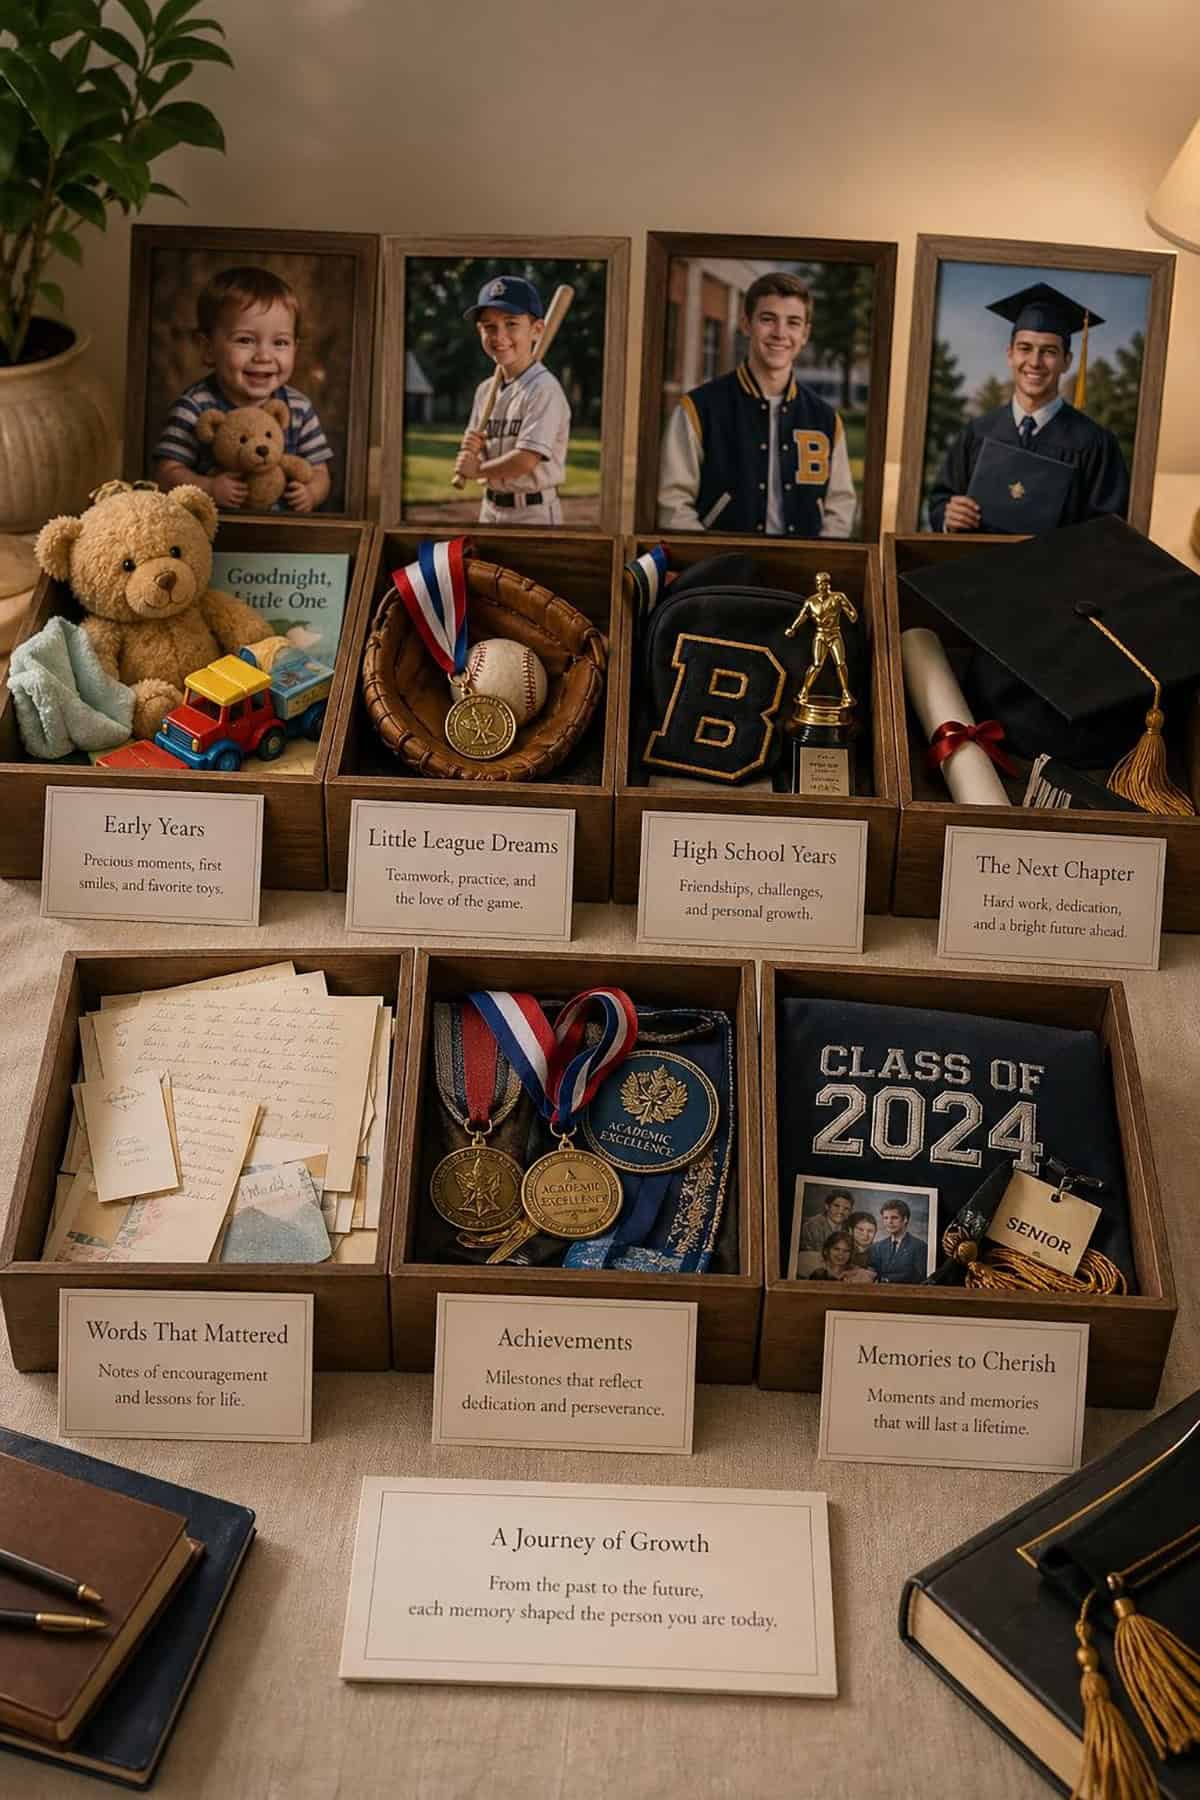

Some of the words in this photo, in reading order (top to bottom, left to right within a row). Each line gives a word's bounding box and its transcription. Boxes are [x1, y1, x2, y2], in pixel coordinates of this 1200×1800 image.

[793, 429, 830, 484] B
[228, 568, 332, 590] Goodnight,
[289, 592, 328, 608] One
[643, 633, 786, 780] B
[104, 815, 151, 840] Early
[159, 818, 205, 837] Years
[368, 828, 417, 848] Little
[423, 831, 485, 855] League
[492, 834, 558, 854] Dreams
[672, 840, 718, 865] High
[725, 842, 785, 862] School
[792, 845, 837, 864] Years
[83, 853, 133, 868] Precious
[137, 857, 195, 872] moments,
[200, 858, 222, 871] first
[976, 855, 1010, 874] The
[1016, 858, 1059, 877] Next
[1064, 861, 1135, 886] Chapter
[79, 877, 119, 891] smiles,
[122, 880, 144, 891] and
[149, 879, 192, 894] favorite
[197, 883, 223, 897] toys.
[385, 868, 453, 884] Teamwork,
[459, 871, 509, 887] practice,
[513, 874, 536, 887] and
[680, 879, 753, 896] Friendships,
[758, 883, 823, 900] challenges,
[395, 893, 415, 905] the
[419, 893, 443, 906] love
[448, 894, 462, 906] of
[464, 895, 483, 907] the
[488, 898, 523, 912] game.
[685, 904, 707, 916] and
[712, 905, 762, 920] personal
[767, 907, 813, 922] growth.
[983, 894, 1013, 909] Hard
[1019, 898, 1052, 911] work,
[1056, 899, 1121, 916] dedication,
[973, 918, 996, 930] and
[999, 923, 1005, 931] a
[1010, 920, 1046, 936] bright
[1049, 921, 1086, 935] future
[1090, 925, 1127, 938] ahead.
[820, 1044, 972, 1085] CLASS
[990, 1058, 1048, 1095] OF
[608, 1122, 672, 1145] ACADEMIC
[812, 1082, 1043, 1177] 2024
[1006, 1216, 1071, 1256] SENIOR
[86, 1320, 147, 1341] Words
[153, 1322, 198, 1342] That
[205, 1323, 288, 1344] Mattered
[498, 1328, 633, 1350] Achievements
[857, 1345, 951, 1368] Memories
[958, 1354, 975, 1369] to
[983, 1351, 1056, 1373] Cherish
[98, 1363, 139, 1378] Notes
[144, 1365, 160, 1378] of
[162, 1370, 268, 1384] encouragement
[486, 1369, 562, 1386] Milestones
[567, 1372, 593, 1387] that
[599, 1373, 643, 1388] reflect
[115, 1390, 140, 1404] and
[145, 1391, 191, 1406] lessons
[196, 1392, 216, 1406] for
[220, 1392, 245, 1406] life.
[462, 1395, 536, 1411] dedication
[540, 1399, 566, 1413] and
[571, 1402, 665, 1417] perseverance.
[867, 1388, 936, 1405] Moments
[939, 1392, 965, 1406] and
[970, 1395, 1039, 1409] memories
[874, 1414, 900, 1430] that
[906, 1416, 929, 1431] will
[935, 1417, 957, 1431] last
[961, 1423, 968, 1432] a
[974, 1418, 1030, 1435] lifetime.
[491, 1528, 507, 1546] A
[512, 1528, 595, 1555] Journey
[602, 1531, 624, 1550] of
[630, 1532, 709, 1553] Growth
[488, 1575, 531, 1592] From
[536, 1576, 560, 1593] the
[565, 1580, 597, 1597] past
[601, 1580, 618, 1595] to
[623, 1580, 647, 1596] the
[652, 1580, 703, 1599] future,
[408, 1602, 444, 1617] each
[449, 1605, 515, 1623] memory
[520, 1604, 575, 1624] shaped
[580, 1605, 605, 1622] the
[610, 1609, 663, 1626] person
[668, 1612, 696, 1628] you
[702, 1613, 725, 1626] are
[730, 1612, 777, 1628] today.
